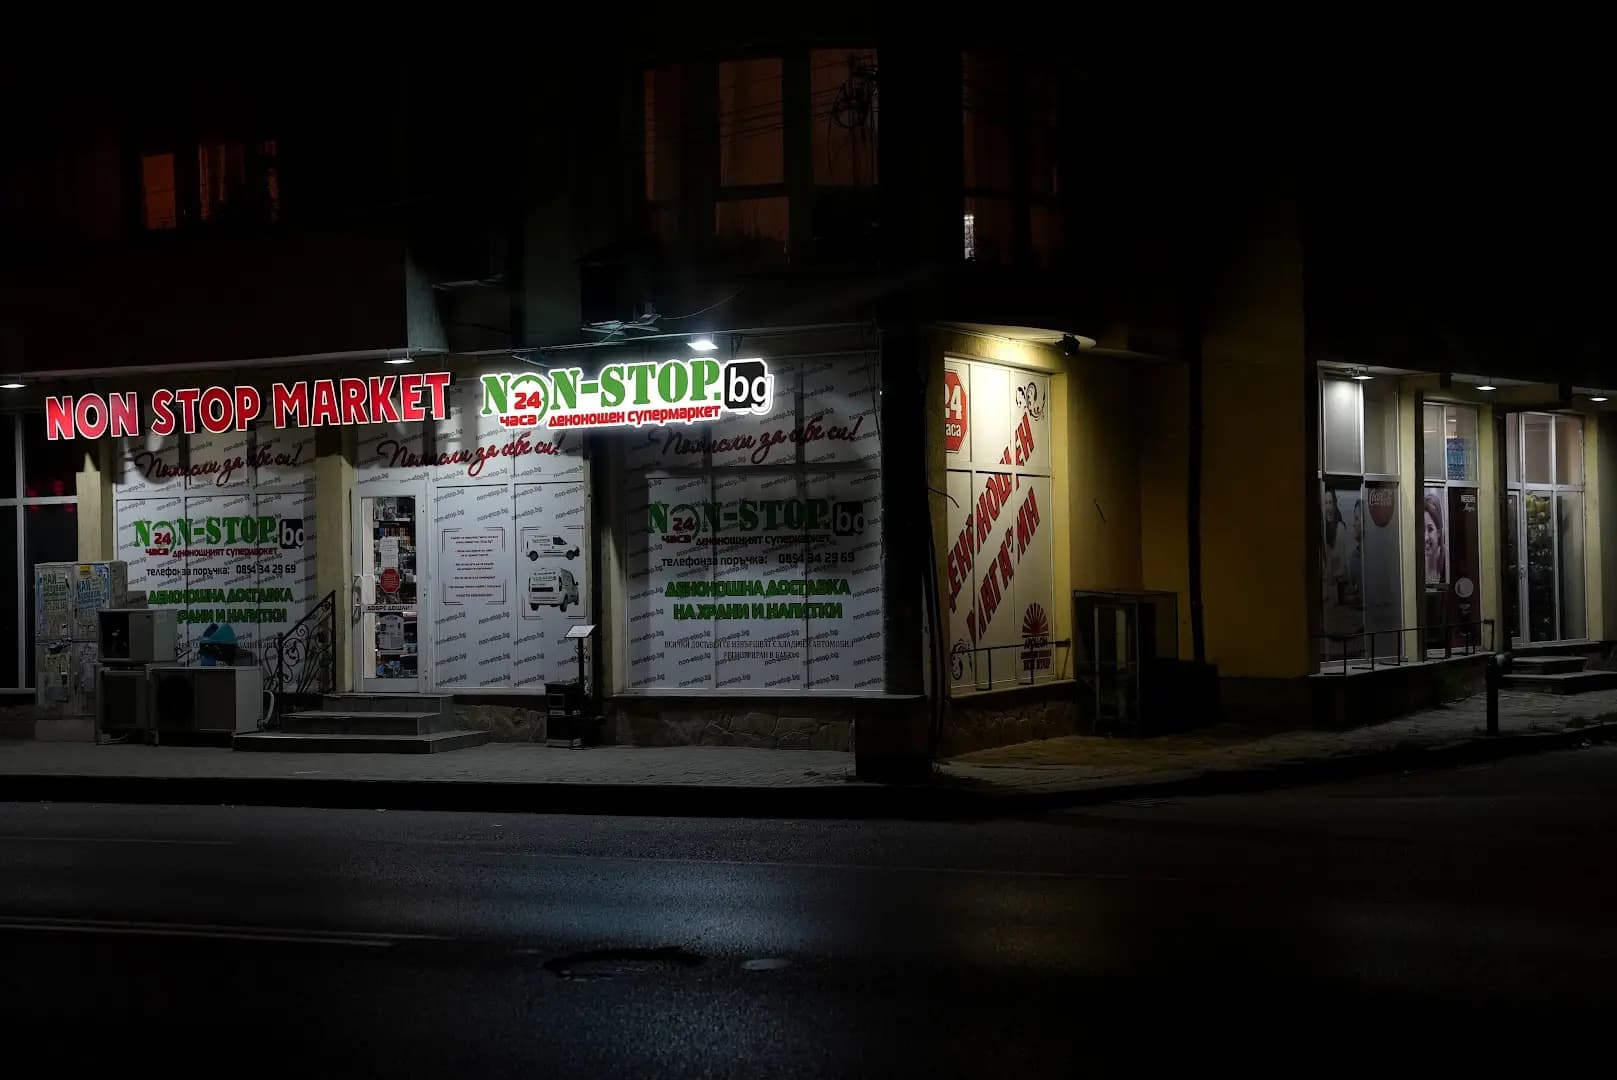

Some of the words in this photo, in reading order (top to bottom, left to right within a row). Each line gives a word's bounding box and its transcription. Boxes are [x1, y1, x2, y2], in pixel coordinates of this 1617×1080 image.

[46, 391, 139, 441] NON
[150, 385, 261, 436] STOP
[272, 371, 451, 429] MARKET
[514, 392, 542, 410] 24
[499, 414, 537, 427] часа
[627, 405, 721, 425] супермаркет
[945, 424, 962, 437] аса
[751, 430, 787, 464] за
[467, 444, 499, 477] за
[673, 518, 695, 531] 24
[154, 532, 172, 545] 24
[285, 564, 296, 573] 69
[673, 604, 697, 620] НА
[697, 603, 750, 620] ХРАНИ
[752, 603, 764, 619] И
[766, 603, 843, 619] НАПИТКИ
